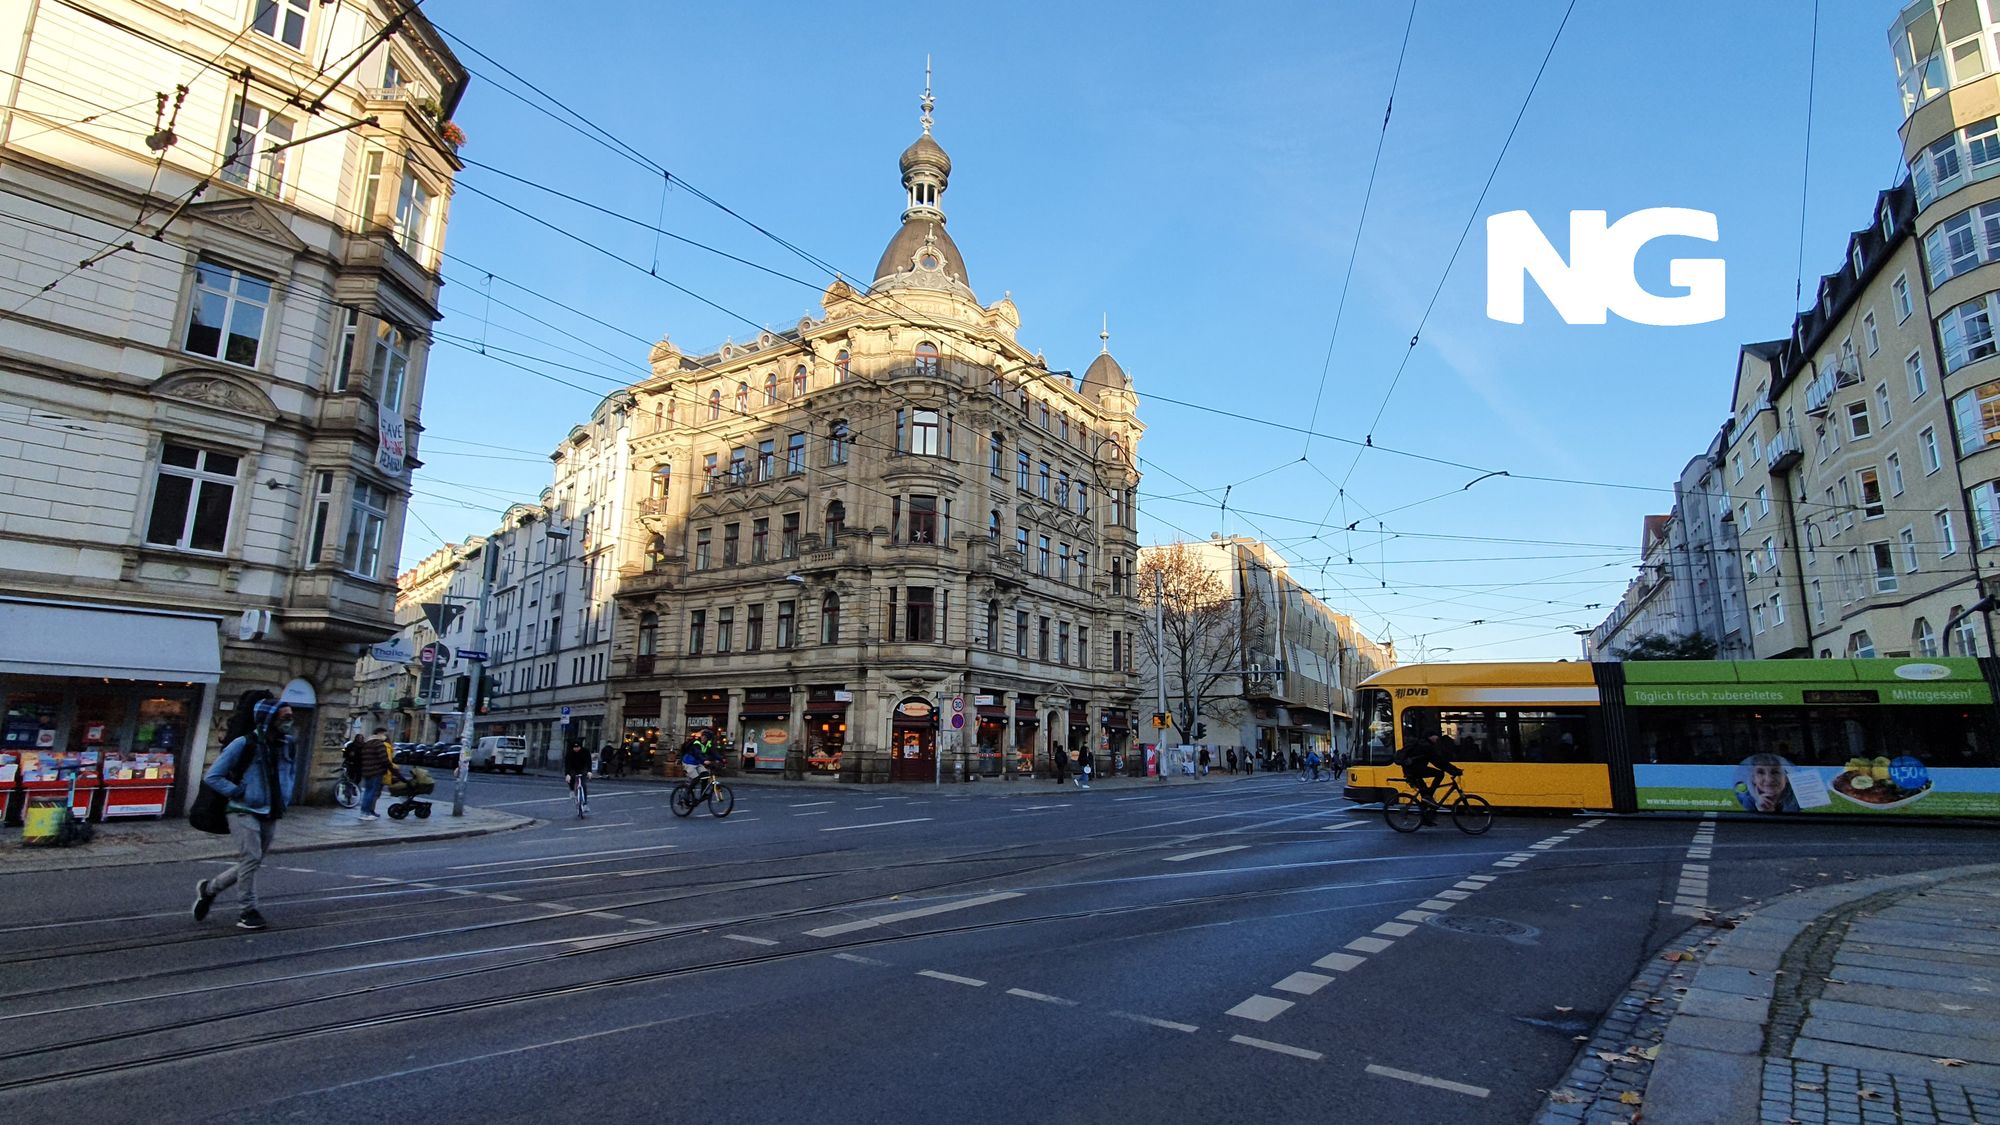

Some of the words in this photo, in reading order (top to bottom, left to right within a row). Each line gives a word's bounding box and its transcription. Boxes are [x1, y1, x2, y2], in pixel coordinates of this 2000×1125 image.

[1406, 688, 1429, 696] DVB
[1677, 690, 1709, 701] frisch
[1713, 691, 1784, 700] zubereitetes
[1892, 689, 1973, 702] Mittagessen!
[954, 701, 963, 709] 30
[1891, 766, 1918, 782] 4,50
